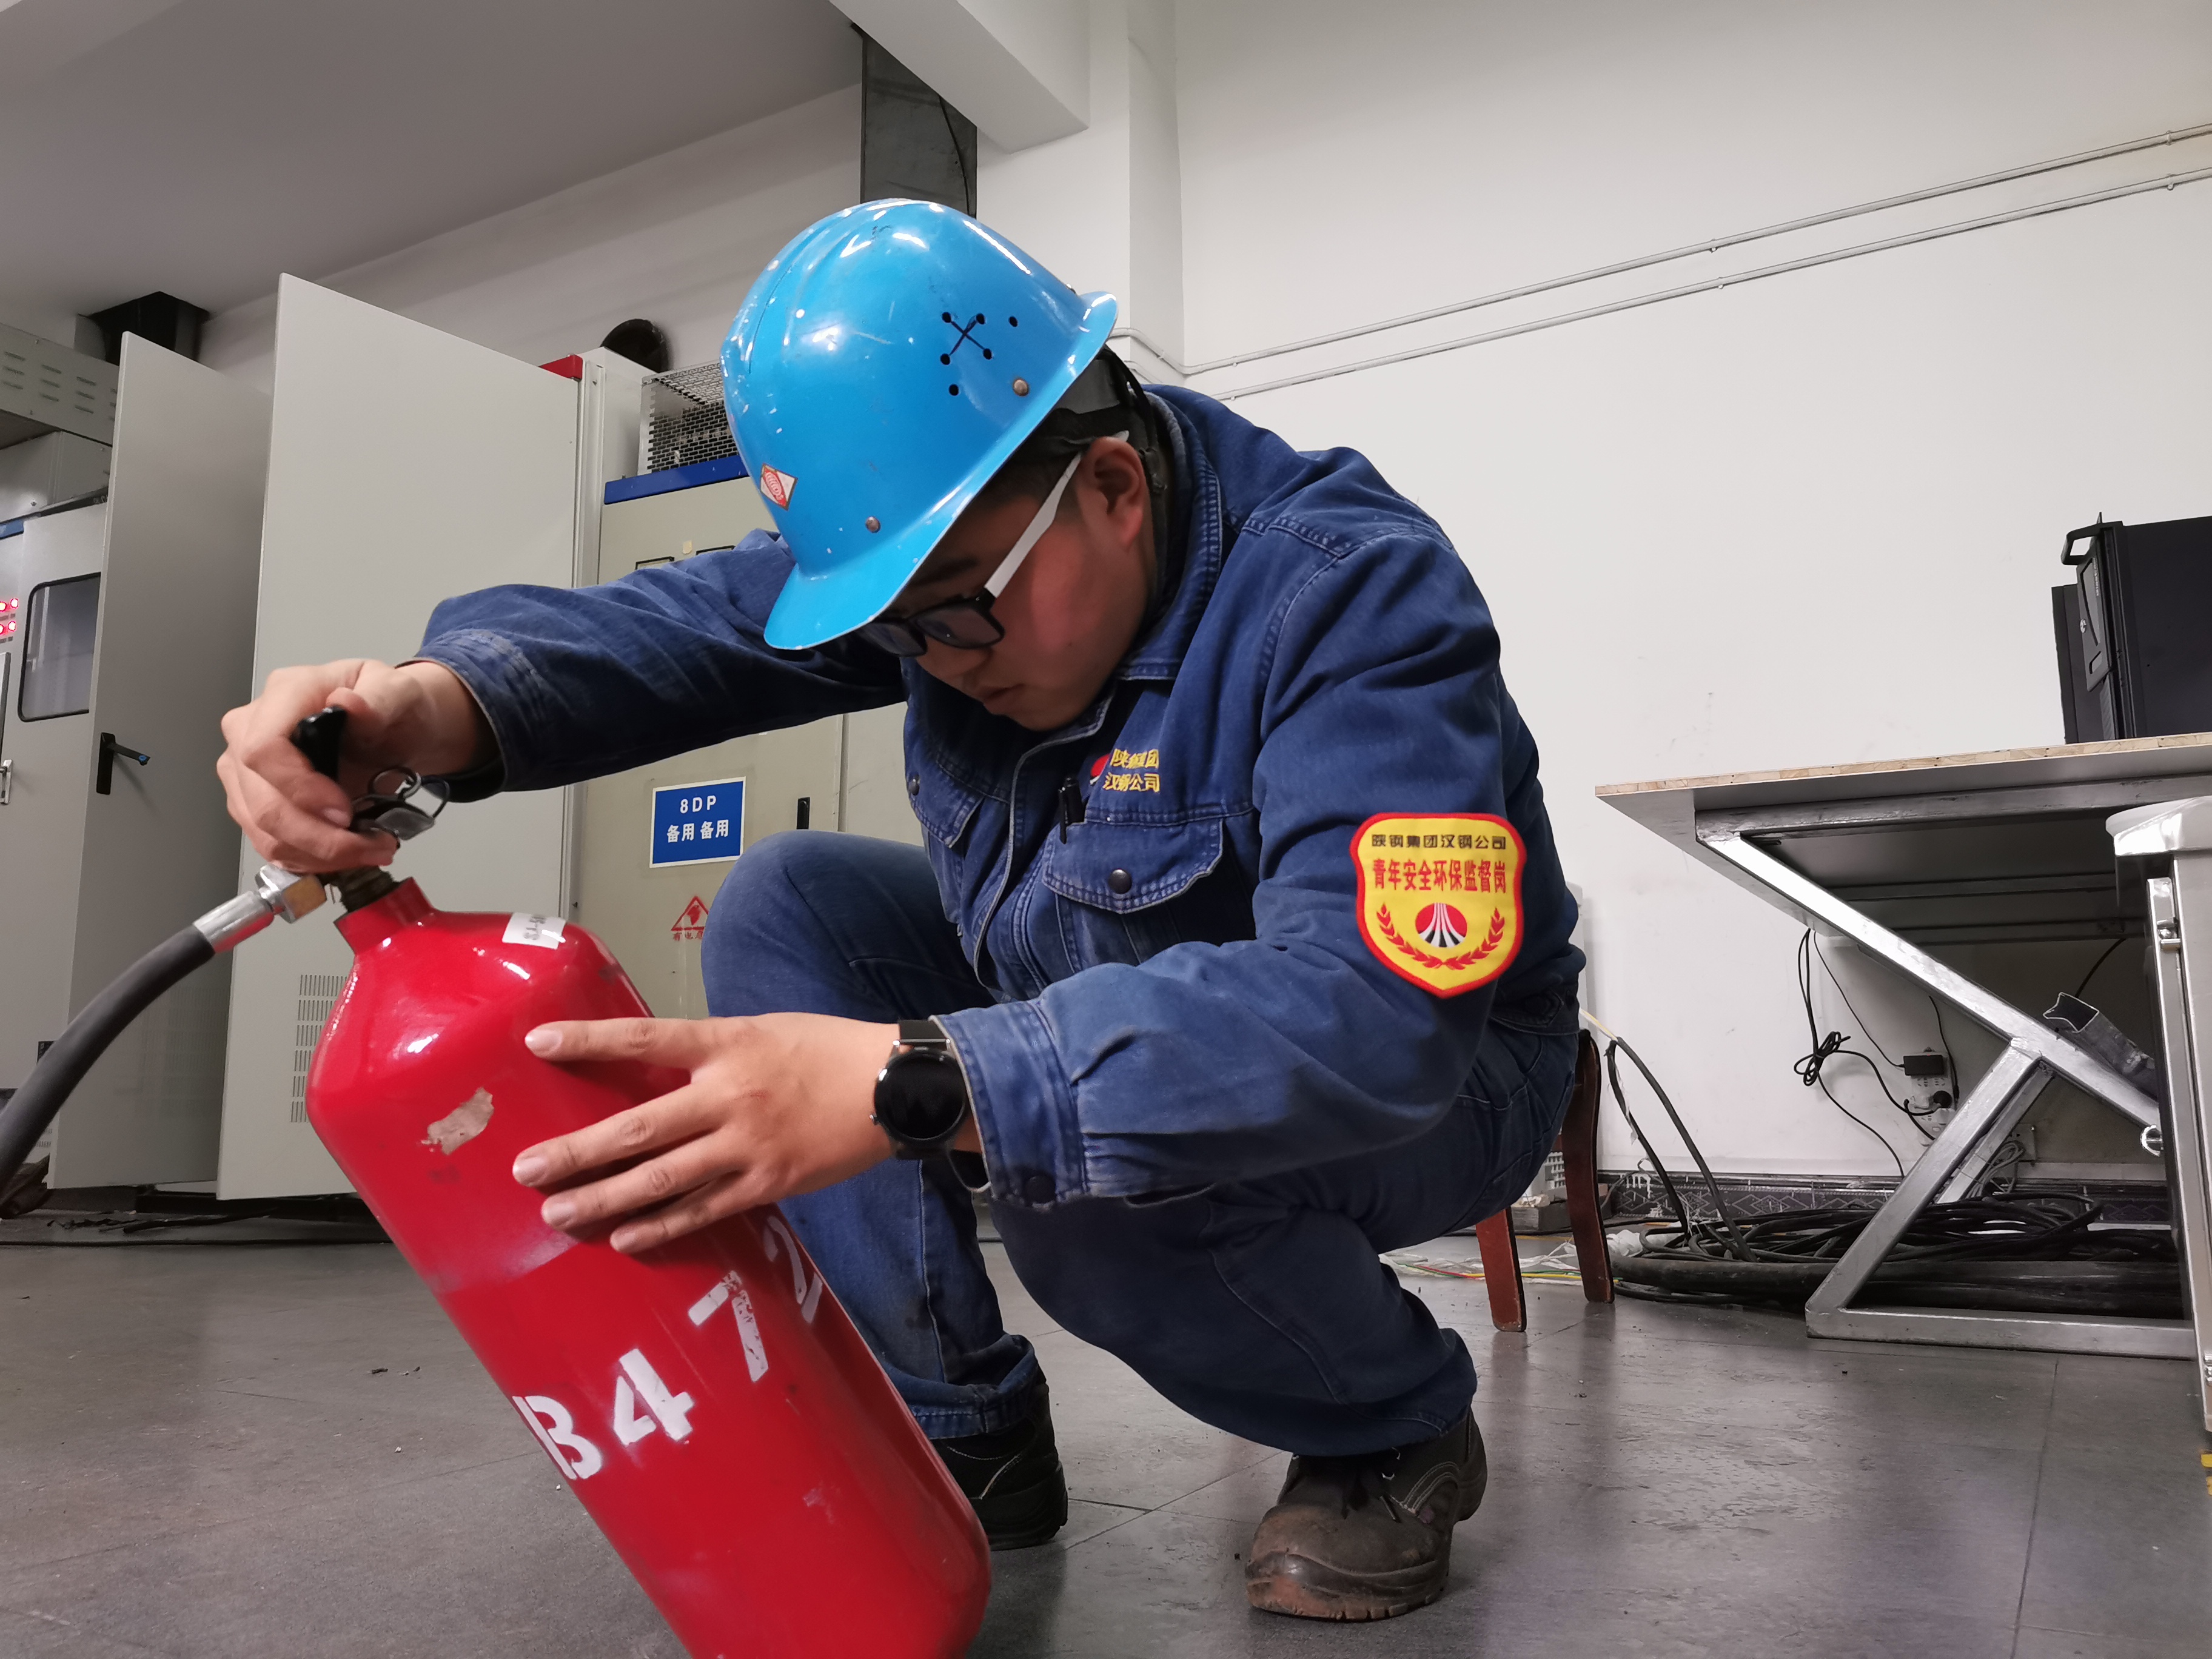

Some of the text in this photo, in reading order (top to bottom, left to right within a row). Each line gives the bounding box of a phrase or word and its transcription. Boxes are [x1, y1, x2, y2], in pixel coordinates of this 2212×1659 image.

[680, 795, 716, 814] 8DP
[1372, 834, 1506, 850] 陕钢集团汉钢公司
[1373, 858, 1506, 894] 青年安全环保监督岗
